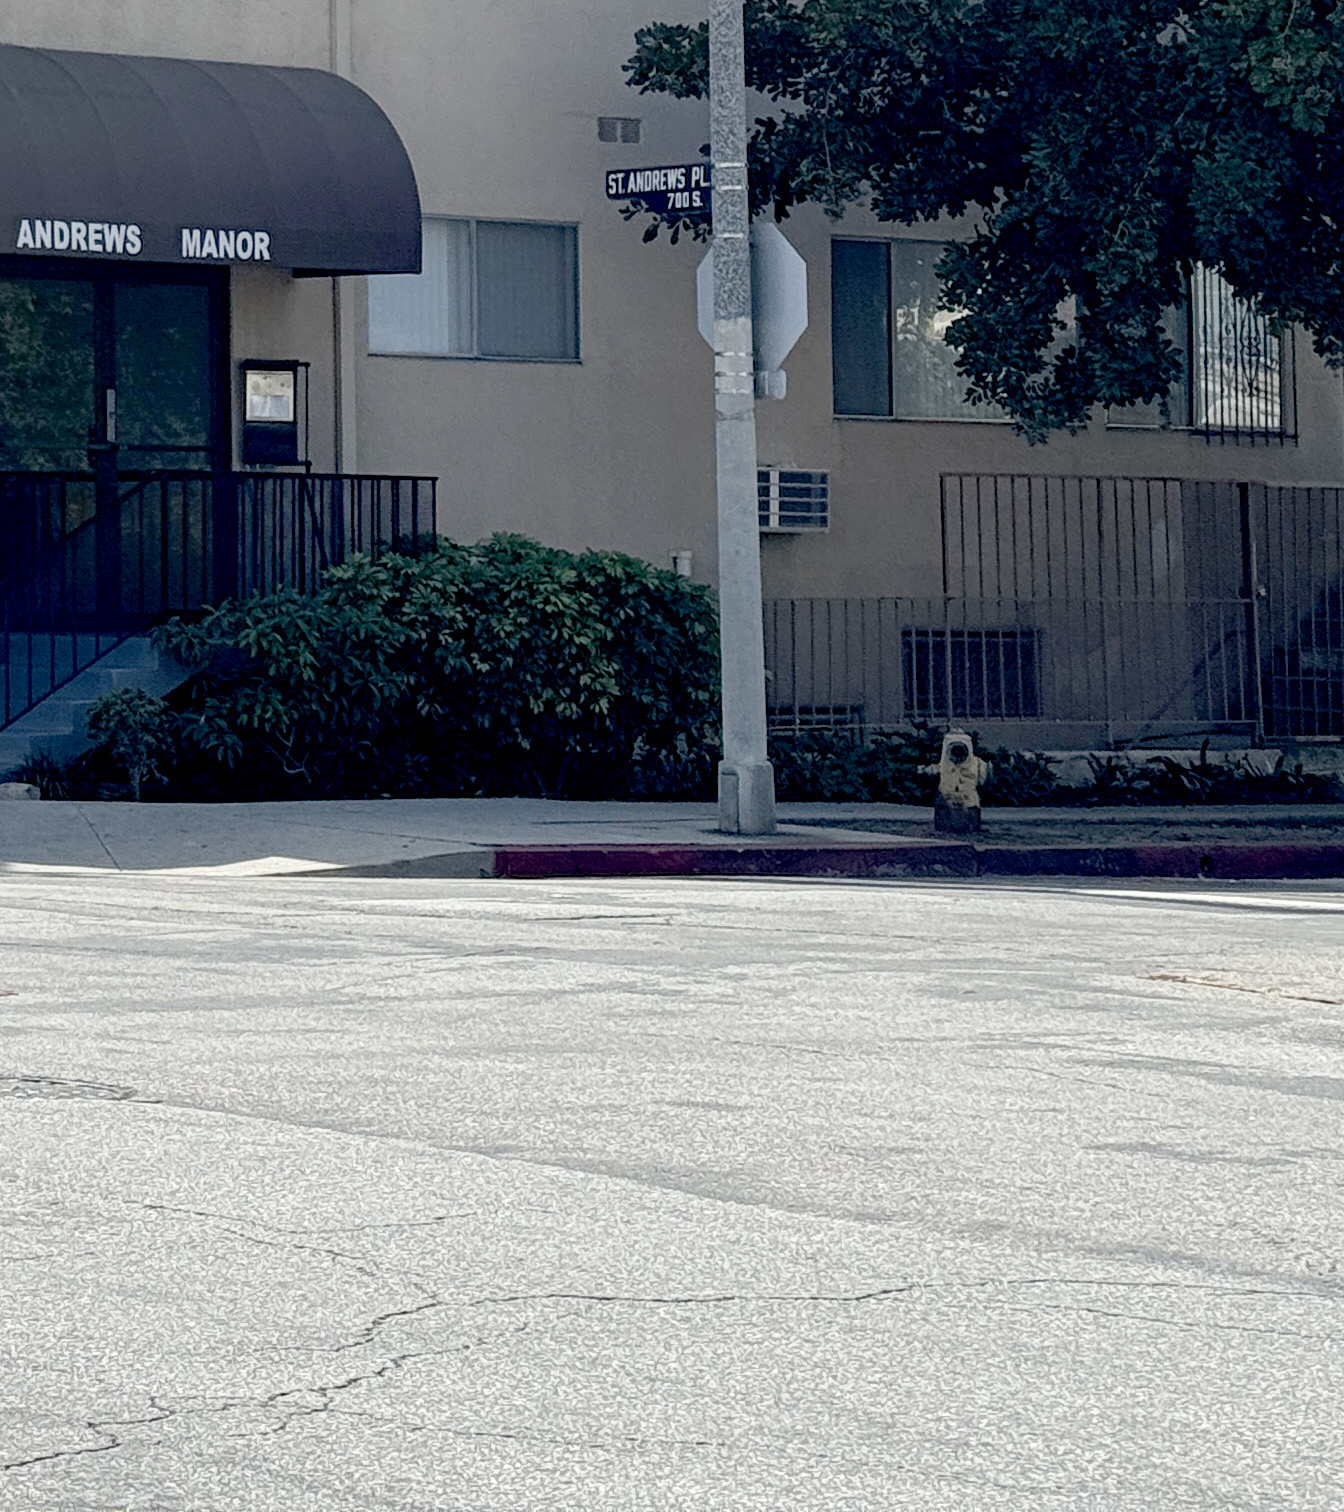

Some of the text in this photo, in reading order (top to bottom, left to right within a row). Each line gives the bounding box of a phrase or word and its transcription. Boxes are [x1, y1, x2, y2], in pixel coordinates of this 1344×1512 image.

[627, 168, 687, 194] ANDREWS
[667, 192, 690, 210] 700
[16, 219, 271, 261] ANDREWS MANOR
